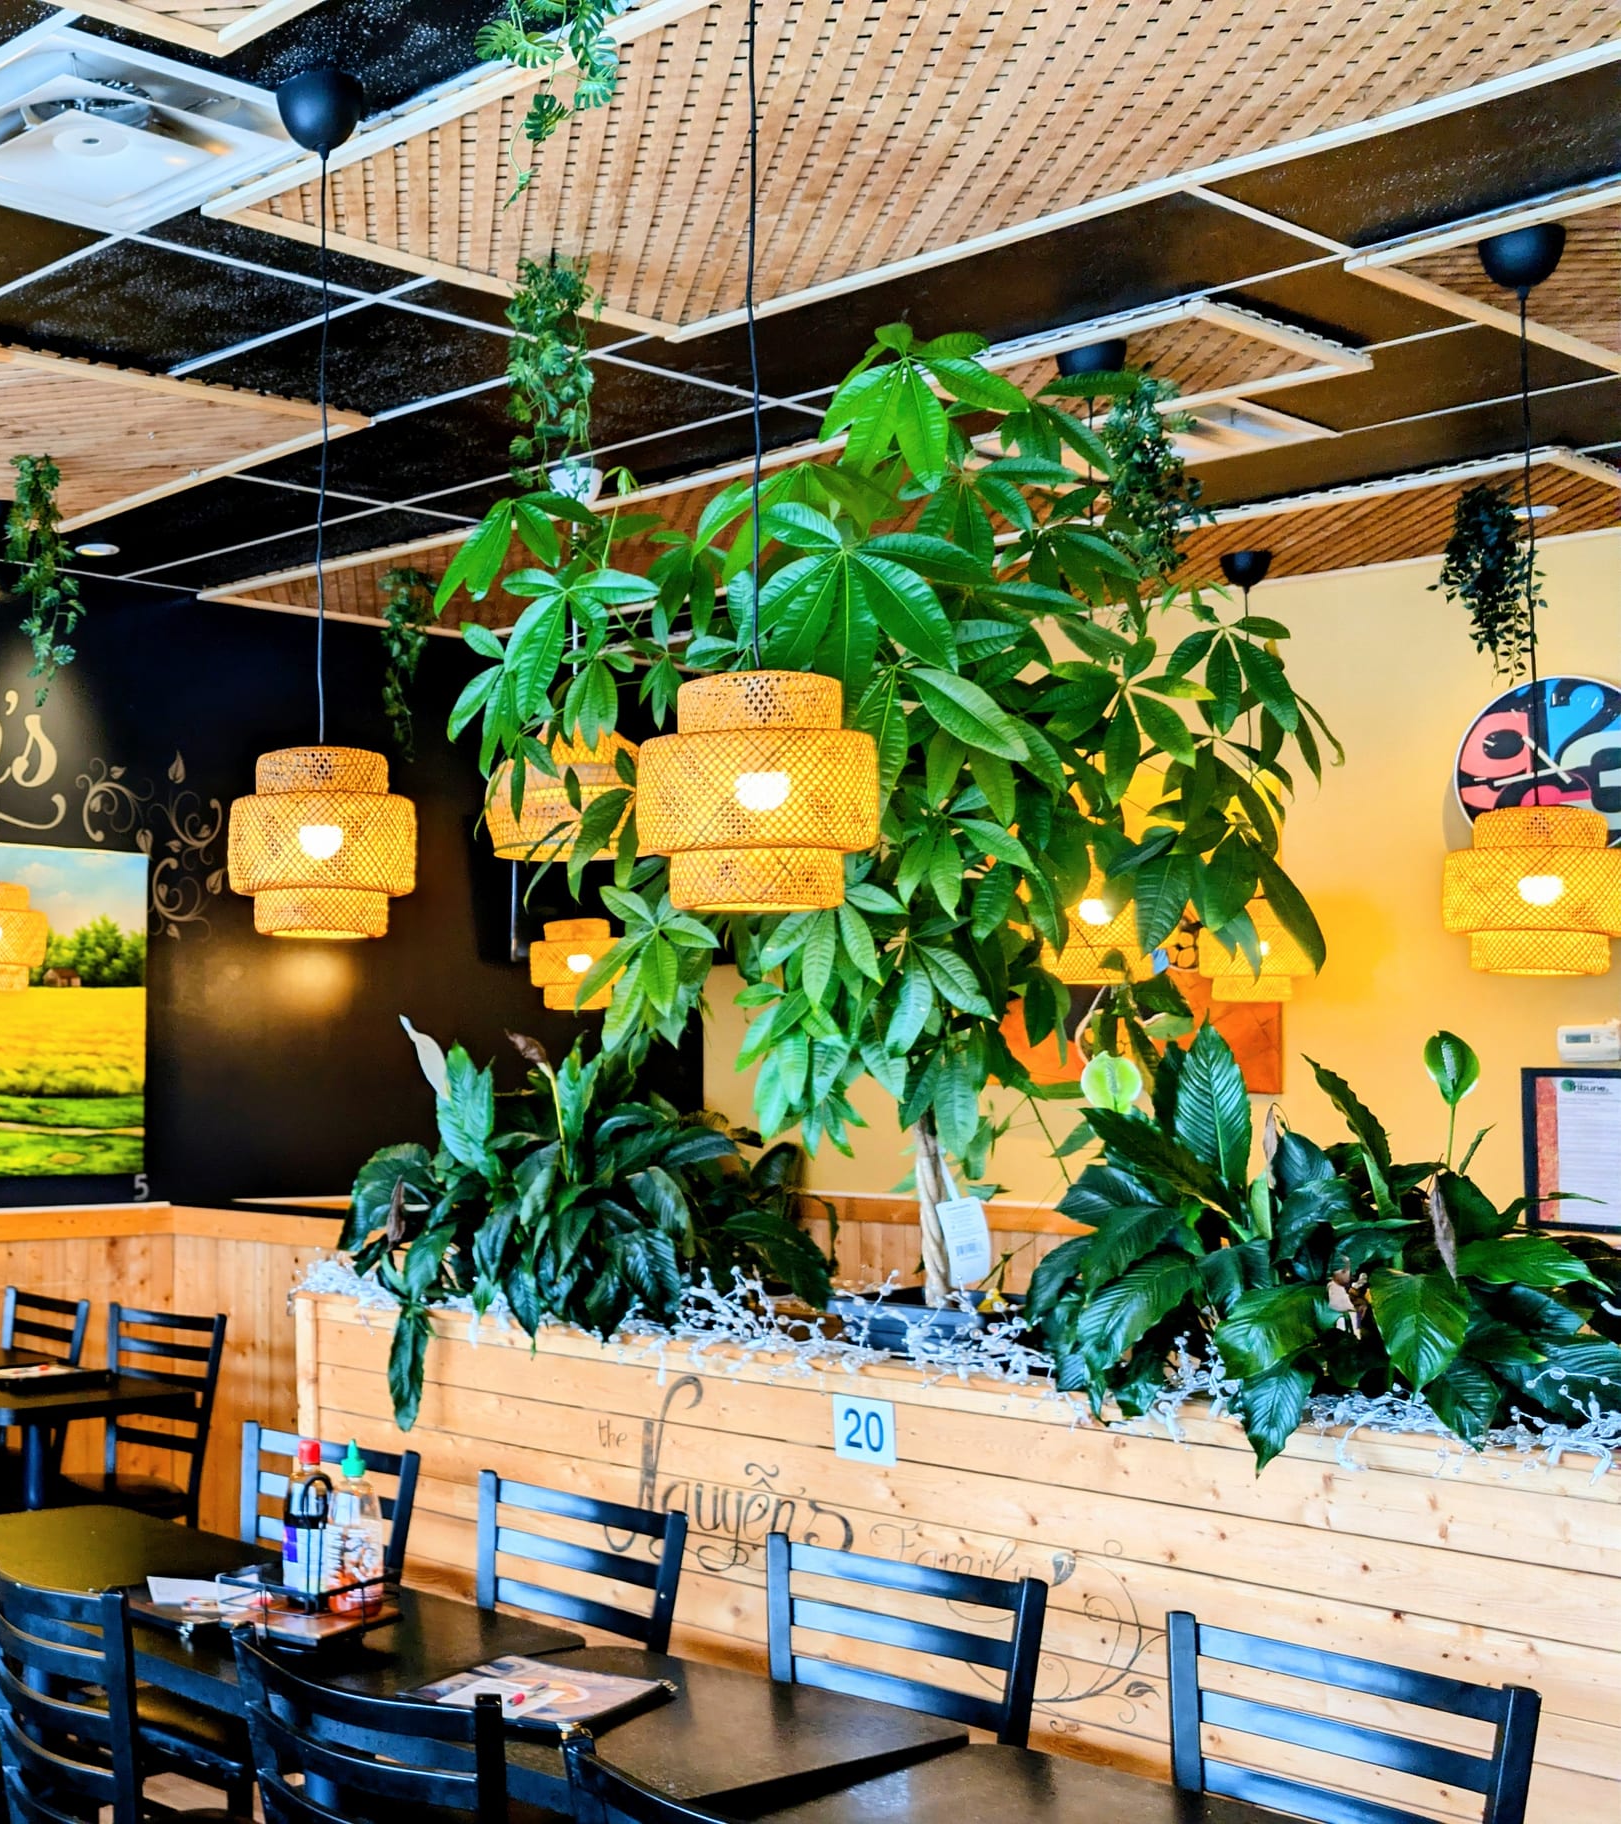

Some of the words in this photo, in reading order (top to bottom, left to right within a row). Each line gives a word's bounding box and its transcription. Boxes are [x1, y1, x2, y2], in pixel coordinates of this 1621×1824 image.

[134, 1173, 150, 1201] 5
[598, 1419, 628, 1449] the
[844, 1407, 884, 1452] 20
